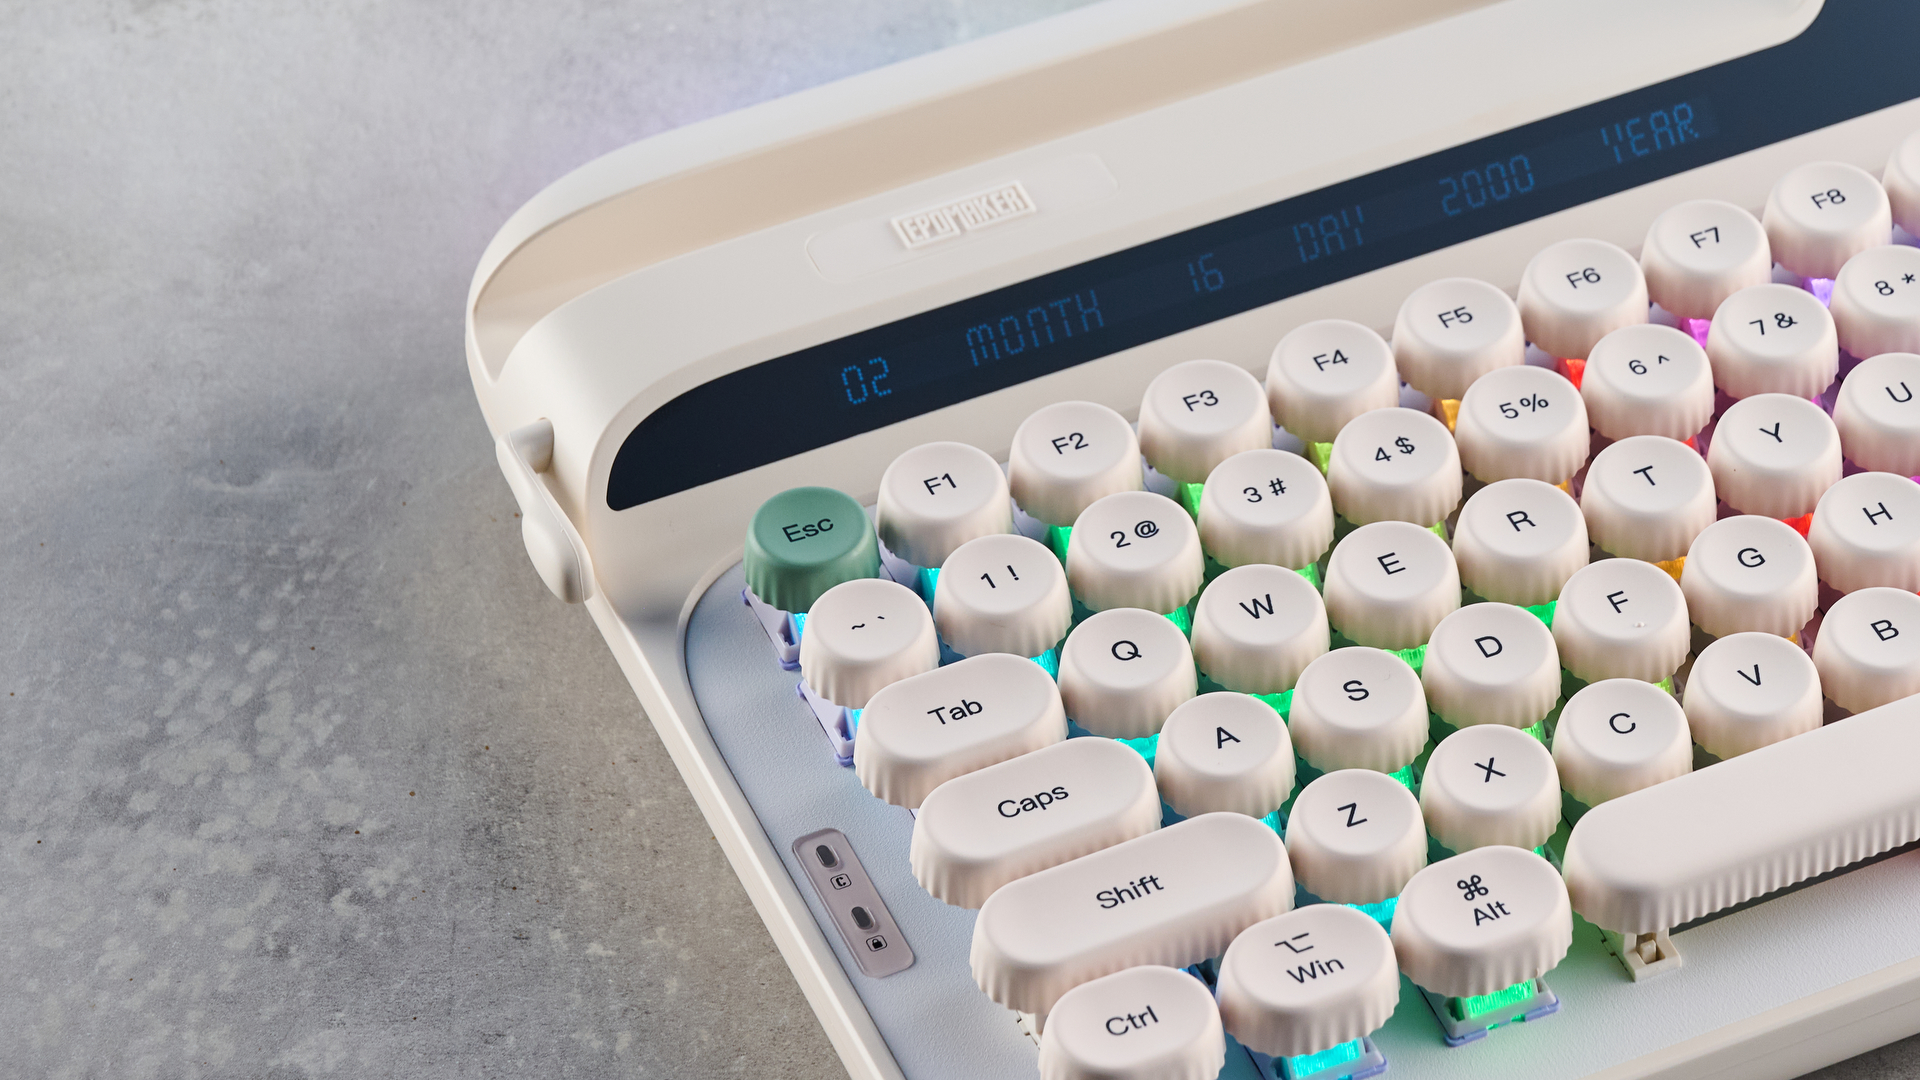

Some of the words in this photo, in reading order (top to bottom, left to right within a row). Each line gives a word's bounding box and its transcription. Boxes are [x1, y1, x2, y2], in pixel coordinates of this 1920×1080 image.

[1811, 189, 1846, 209] F8
[897, 184, 1031, 245] EPOMAKER
[1690, 227, 1719, 248] F7
[841, 356, 891, 404] 02
[1188, 253, 1225, 293] 16
[1438, 155, 1535, 217] 2000
[1601, 102, 1699, 164] YEAR
[1566, 268, 1601, 289] F6
[1438, 306, 1473, 328] F5
[1313, 349, 1348, 371] F4
[1629, 360, 1647, 375] 6
[1183, 390, 1219, 412] F3
[1885, 382, 1912, 403] U
[1052, 432, 1089, 454] F2
[1759, 422, 1782, 443] Y
[923, 473, 956, 495] F1
[1633, 465, 1655, 486] T
[1506, 511, 1536, 532] R
[1862, 502, 1893, 525] H
[782, 518, 833, 542] Esc
[1377, 552, 1406, 575] E
[1737, 548, 1765, 568] G
[1239, 594, 1274, 619] W
[1607, 591, 1628, 613] F
[1870, 620, 1899, 641] B
[1111, 640, 1142, 661] Q
[1474, 636, 1502, 658] D
[1737, 664, 1761, 686] V
[1343, 680, 1369, 701] S
[927, 699, 983, 725] Tab
[1609, 713, 1636, 734] C
[1217, 727, 1241, 749] A
[1474, 757, 1506, 783] X
[998, 787, 1069, 818] Caps
[1337, 802, 1367, 827] Z
[1096, 875, 1164, 909] Shift
[1473, 900, 1511, 927] Alt
[1286, 959, 1345, 984] Win
[1106, 1005, 1158, 1036] Ctrl
